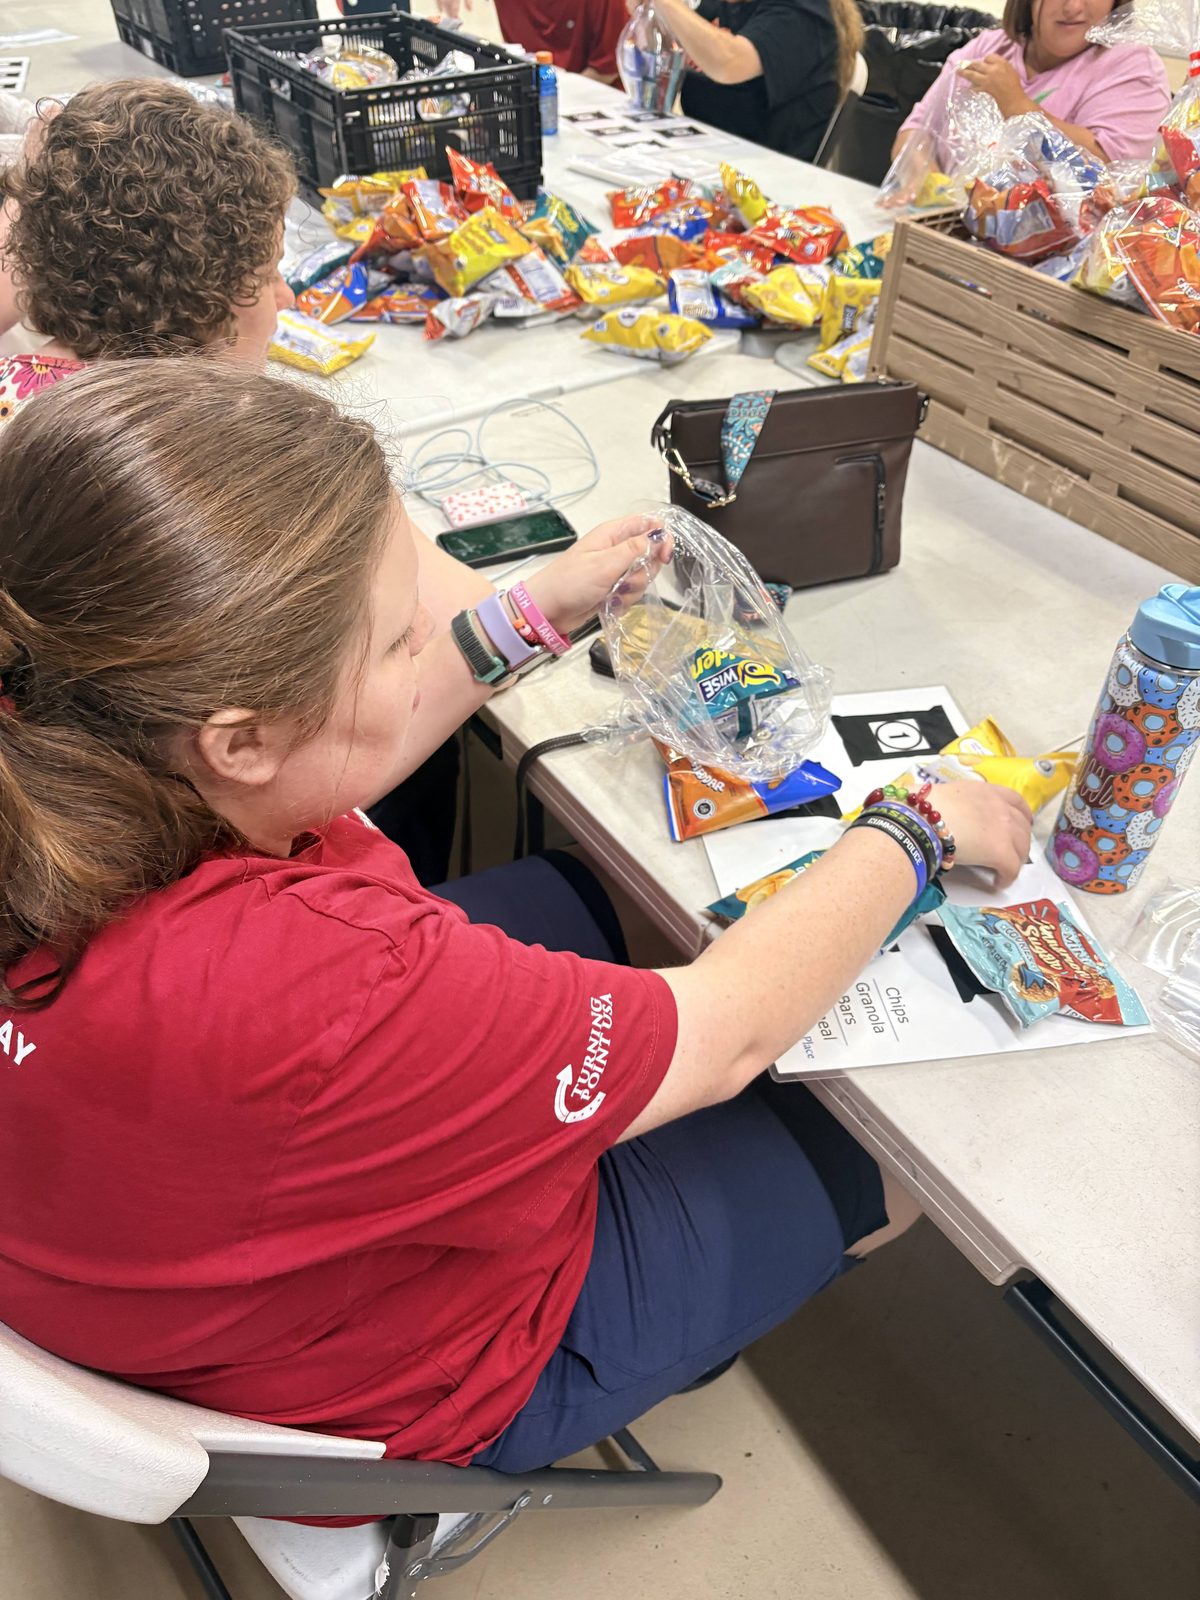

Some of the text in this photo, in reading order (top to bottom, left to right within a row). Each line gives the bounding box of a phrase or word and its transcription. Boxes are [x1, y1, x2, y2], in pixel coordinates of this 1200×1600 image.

[536, 621, 556, 645] TAKE
[701, 668, 738, 698] WISE
[867, 816, 904, 846] CUMMING
[903, 837, 923, 866] POLICE
[856, 982, 885, 1034] Granola
[886, 987, 909, 1024] Chips
[580, 993, 613, 1101] POINT USA
[818, 1016, 837, 1041] eal
[571, 997, 603, 1098] TURNING
[802, 1036, 815, 1059] Place
